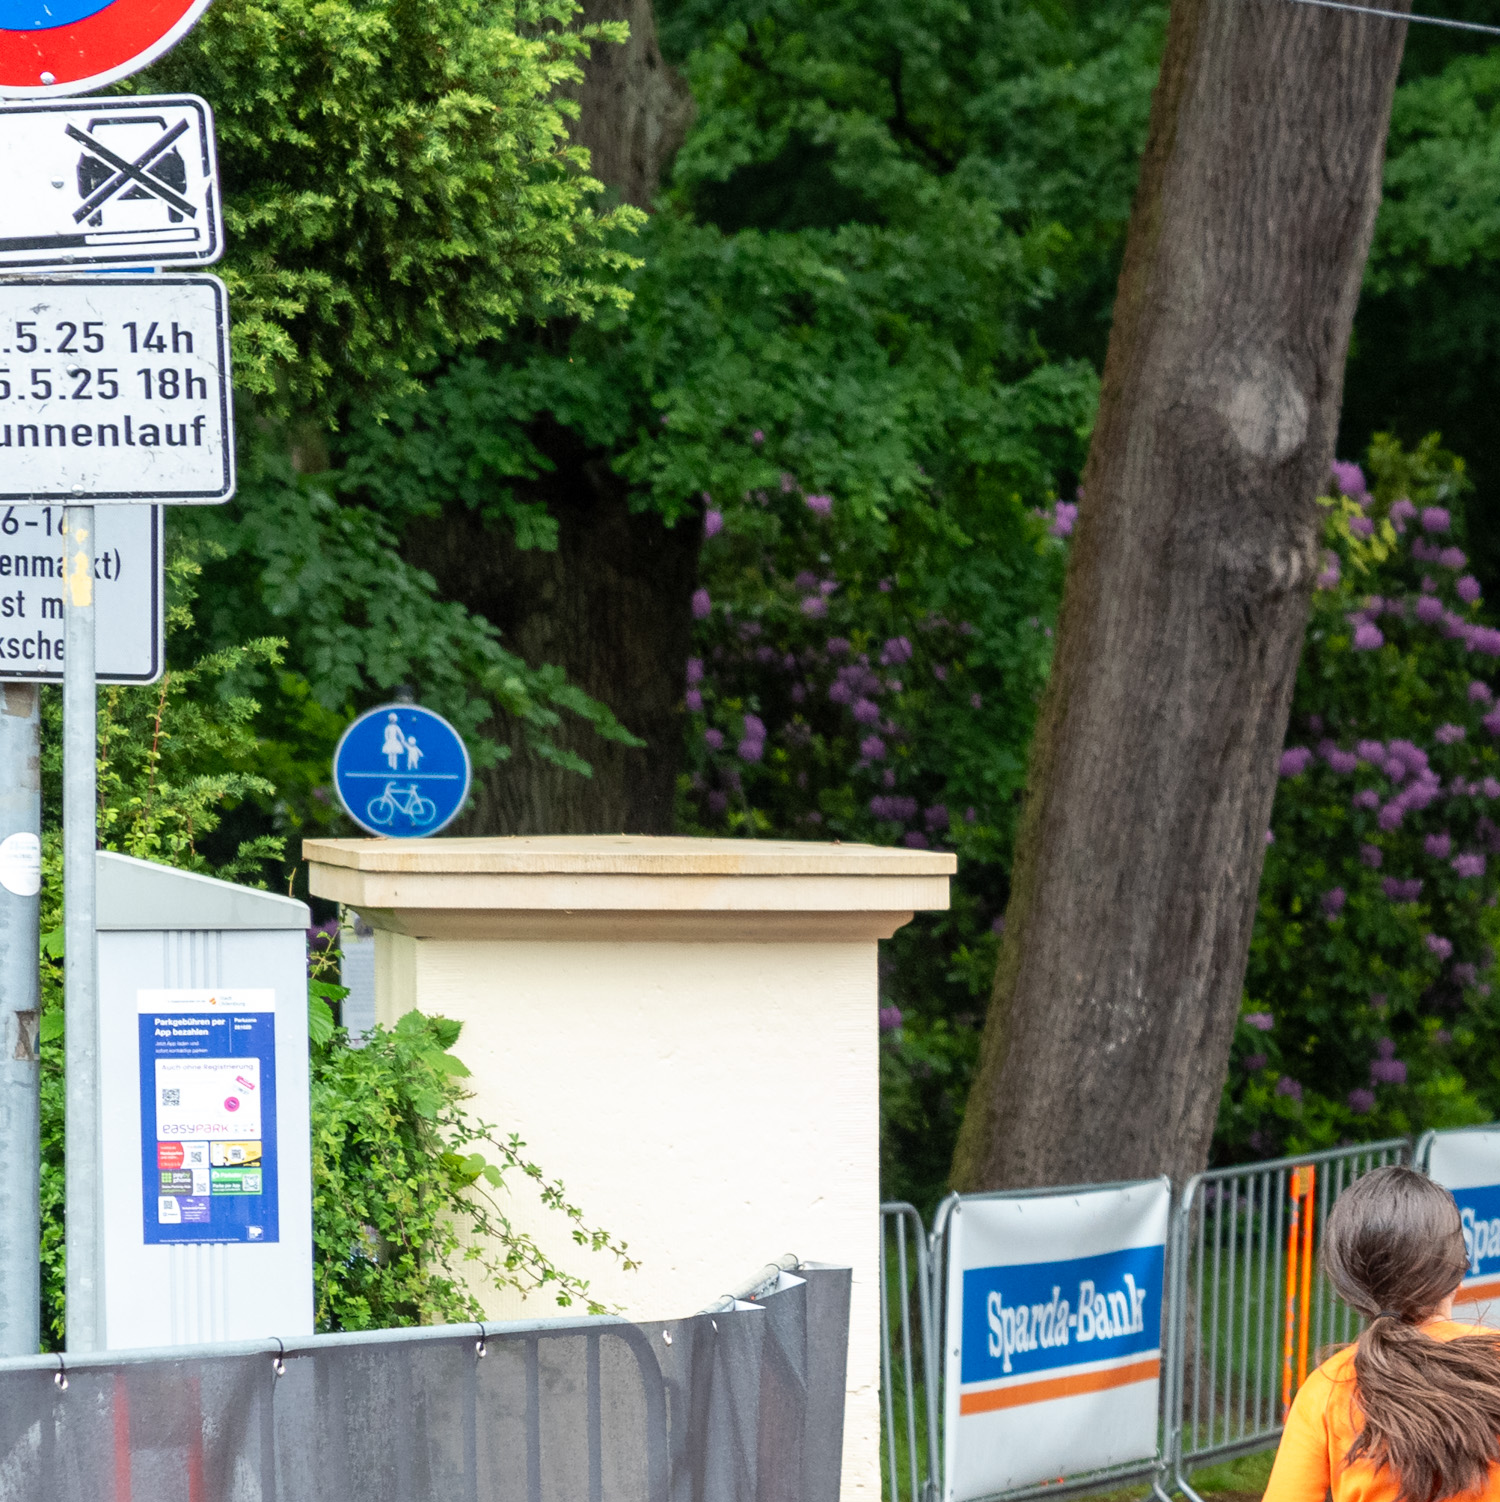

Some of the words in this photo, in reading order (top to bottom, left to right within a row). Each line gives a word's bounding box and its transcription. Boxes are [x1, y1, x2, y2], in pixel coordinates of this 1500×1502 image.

[122, 321, 194, 354] 14h
[137, 368, 207, 400] 18h
[1, 506, 64, 537] 6-1
[154, 1028, 171, 1037] App
[987, 1272, 1147, 1374] Sparda-Bank
